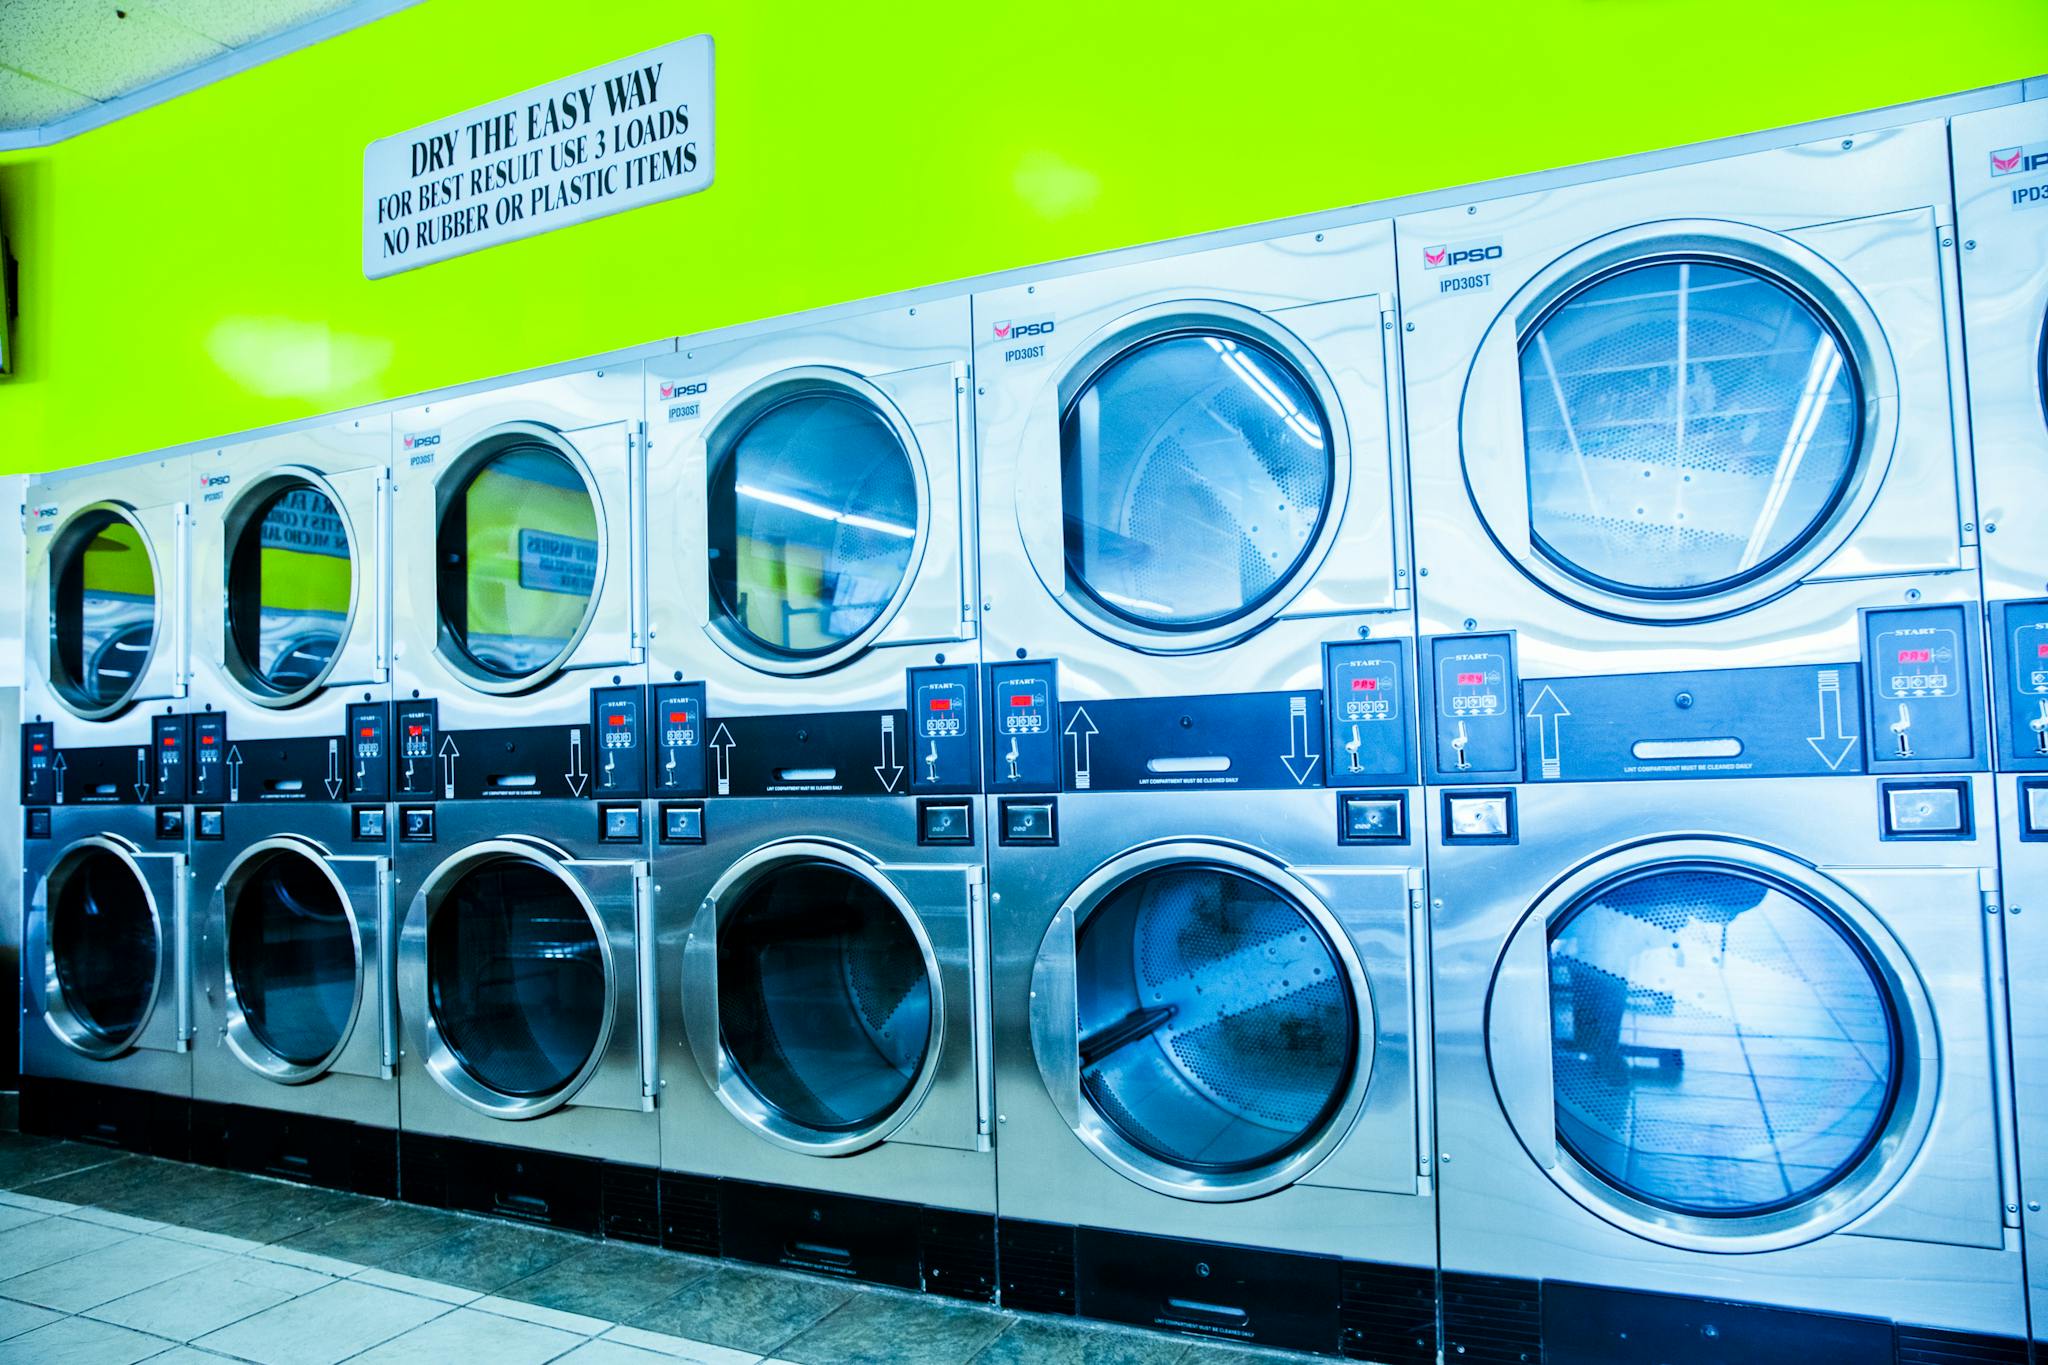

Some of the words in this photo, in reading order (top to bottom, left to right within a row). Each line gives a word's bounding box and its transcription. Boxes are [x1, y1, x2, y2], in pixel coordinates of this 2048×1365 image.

[411, 130, 460, 178] DRY
[466, 110, 518, 160] THE
[527, 84, 596, 141] EASY
[604, 62, 664, 116] WAY
[378, 190, 412, 225] FOR
[418, 172, 464, 212] BEST
[470, 149, 544, 197] RESULT
[550, 135, 588, 172] USE
[595, 129, 606, 160] 3
[614, 104, 690, 153] LOADS
[383, 226, 410, 258] NO
[416, 202, 489, 249] RUBBER
[495, 195, 524, 226] OR
[530, 164, 618, 215] PLASTIC
[625, 142, 698, 189] ITEMS
[1447, 245, 1503, 266] IPSO
[1440, 273, 1491, 293] IPD30ST
[1011, 321, 1054, 339] IPSO
[1005, 345, 1045, 362] IPD30ST
[674, 382, 707, 398] IPSO
[1894, 627, 1937, 637] START
[1455, 653, 1489, 661] START
[1899, 650, 1931, 663] PAY
[1352, 678, 1377, 690] PAY
[1637, 764, 1680, 772] COMPARTMENT
